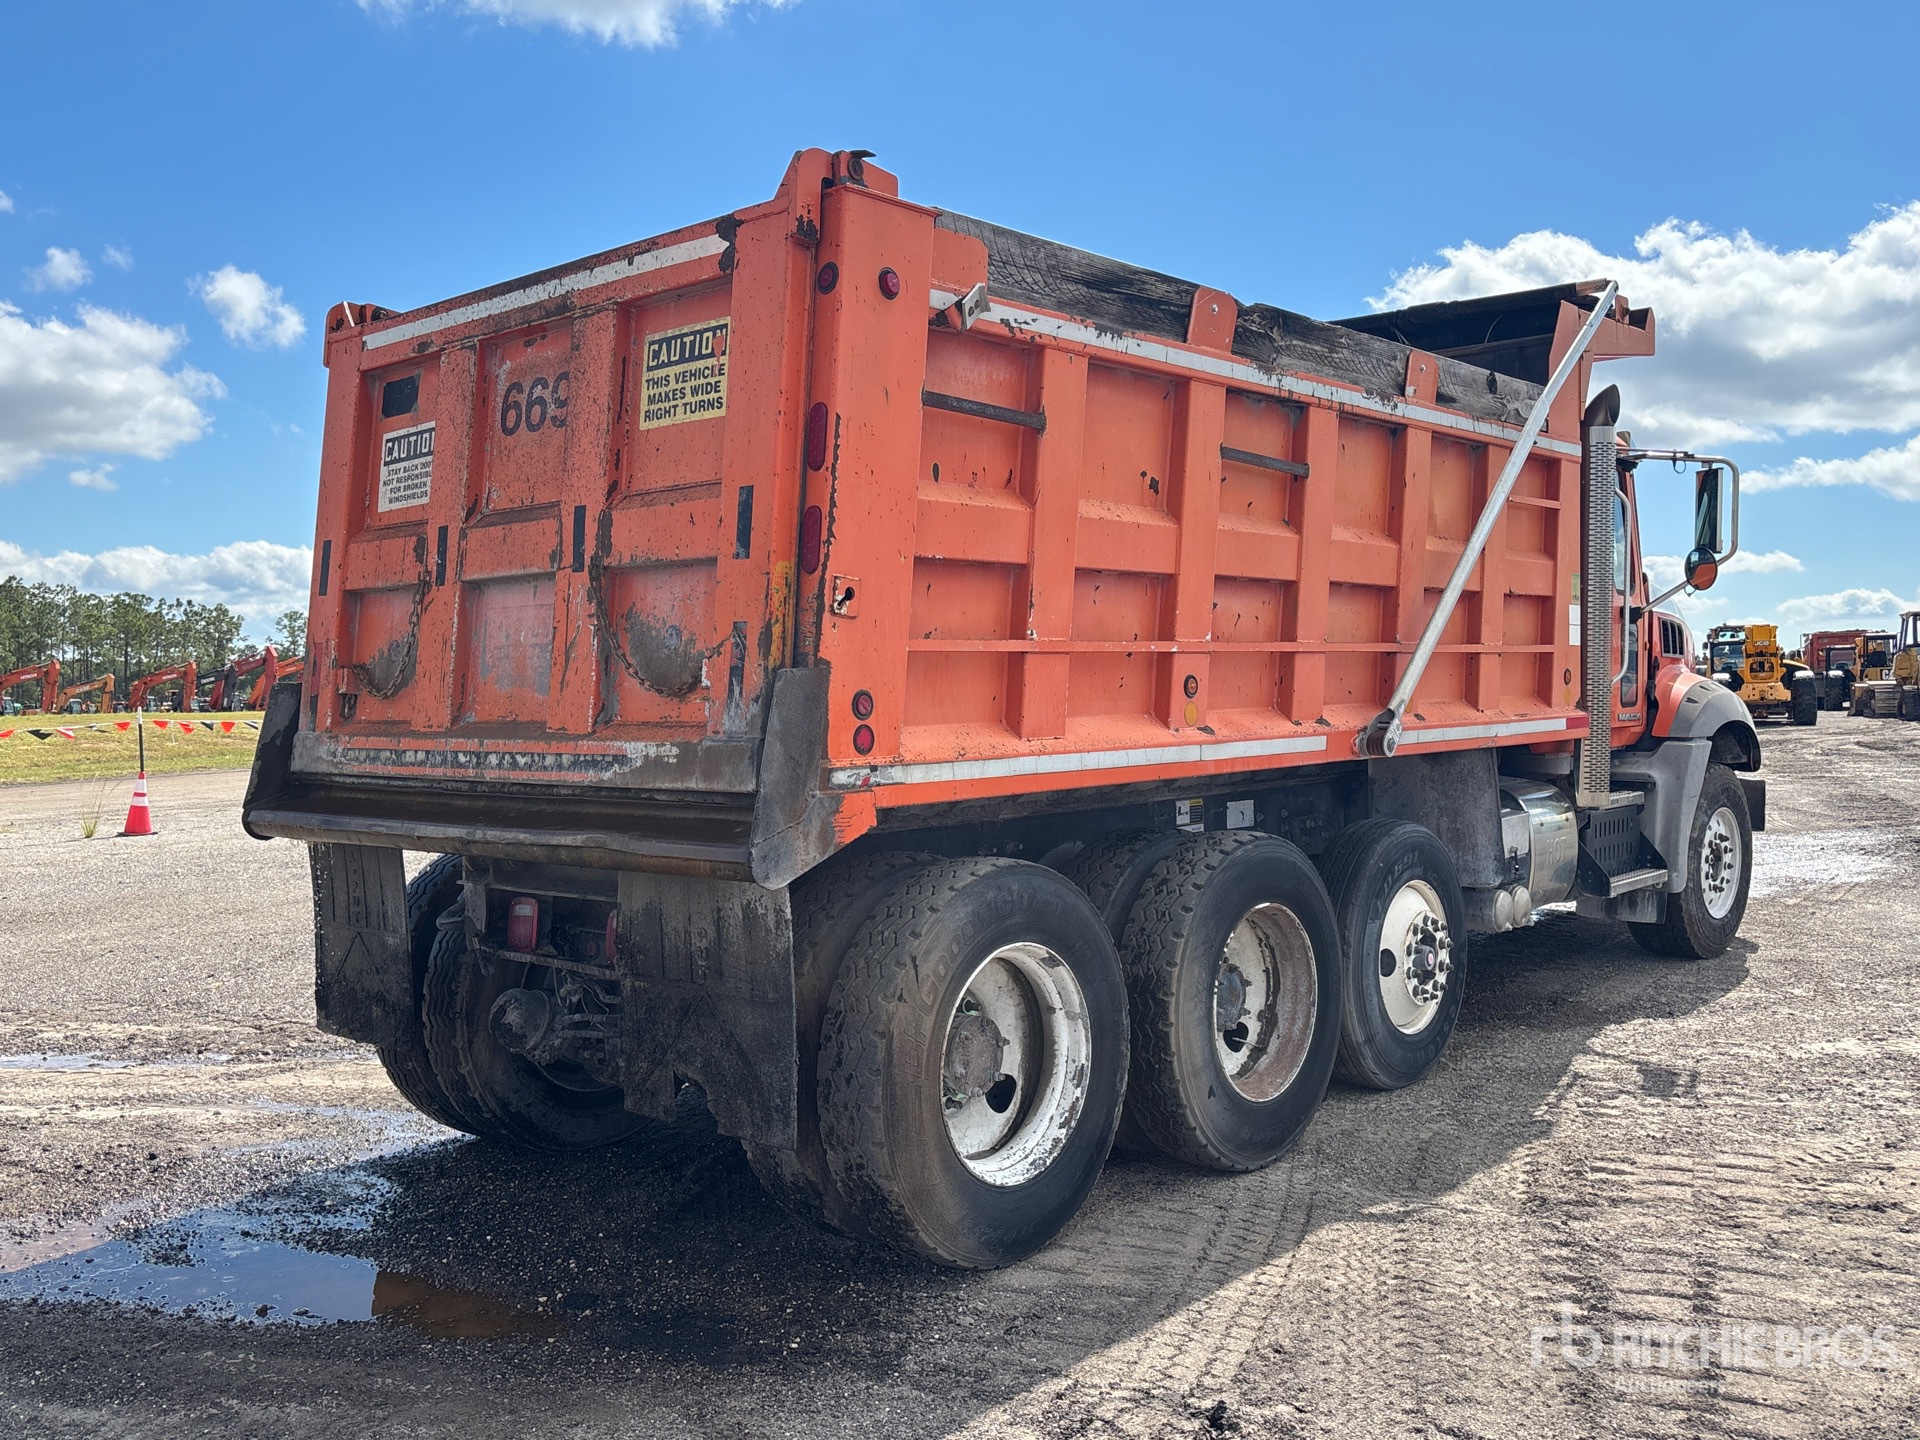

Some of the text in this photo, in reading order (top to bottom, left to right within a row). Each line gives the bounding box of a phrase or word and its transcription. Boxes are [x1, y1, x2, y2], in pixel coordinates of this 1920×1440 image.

[645, 363, 726, 391] THIS VEHICLE
[647, 380, 722, 407] MAKES WIDE
[500, 371, 570, 437] 669
[644, 396, 724, 423] RIGHT TURNS
[382, 470, 432, 488] NOT RESPONSIBL
[387, 467, 403, 478] STAY
[402, 463, 419, 474] BACK
[388, 490, 429, 505] WINDSHIELDS
[389, 481, 428, 496] FOR BROKEN
[1617, 713, 1641, 721] MACK
